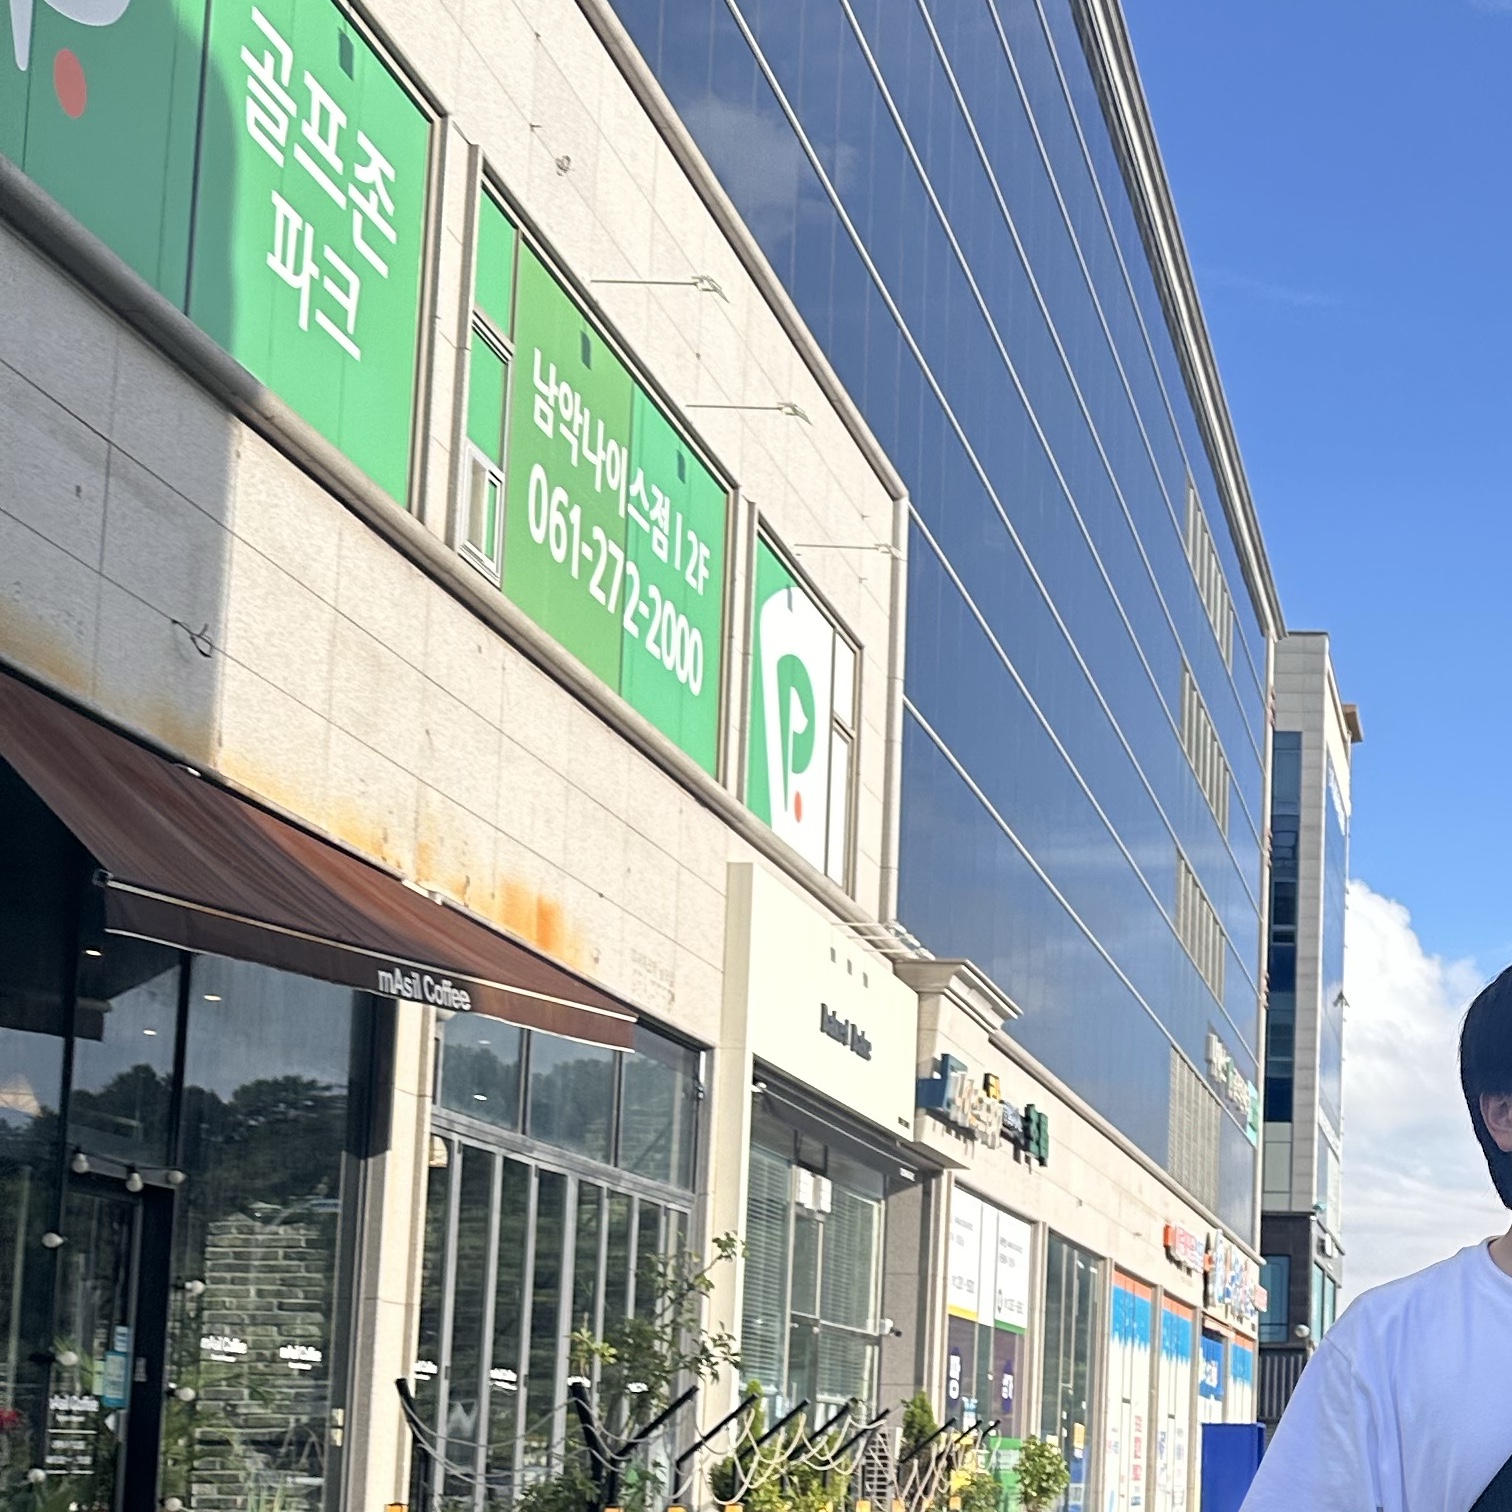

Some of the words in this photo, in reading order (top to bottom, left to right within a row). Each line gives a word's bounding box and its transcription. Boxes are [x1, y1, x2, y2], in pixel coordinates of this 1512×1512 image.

[240, 4, 398, 280] 골프존
[265, 188, 362, 363] 파크
[528, 462, 704, 697] 061-272-2000
[533, 347, 671, 564] 남악나이스점
[685, 530, 710, 596] 2F
[422, 974, 472, 1011] Coffee
